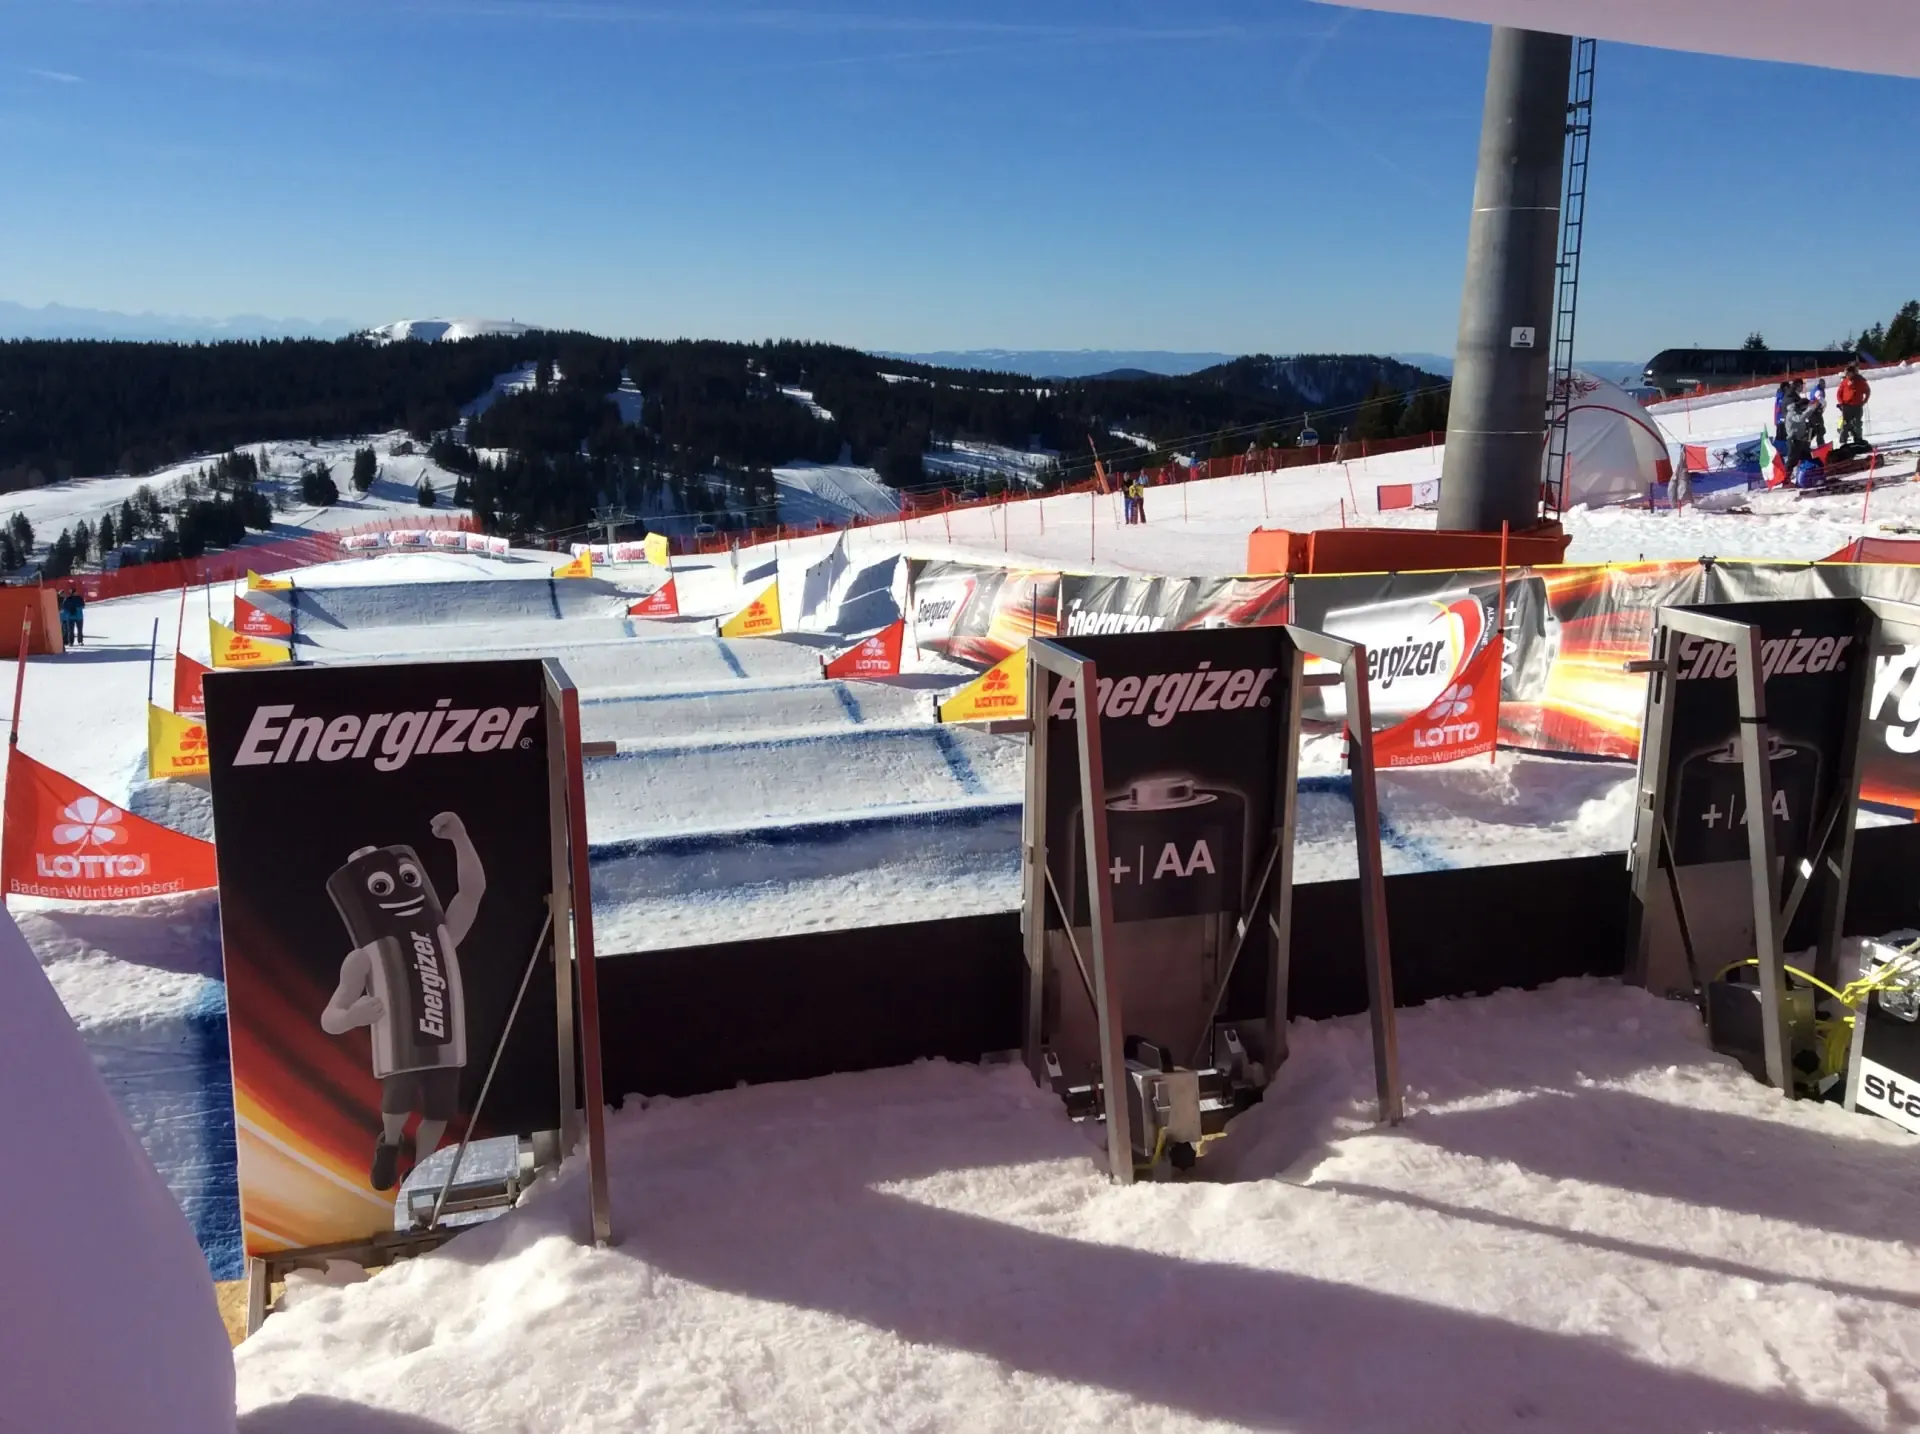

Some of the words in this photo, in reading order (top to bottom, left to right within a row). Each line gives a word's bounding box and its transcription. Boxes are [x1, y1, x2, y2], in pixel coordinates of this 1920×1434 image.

[1519, 329, 1528, 341] 6
[744, 618, 773, 629] LOTTO
[918, 597, 956, 629] Energizer
[856, 659, 891, 670] LOTTO
[1367, 636, 1446, 690] ergizer
[1676, 629, 1853, 686] Enegizer
[974, 696, 1018, 709] LOTTO
[232, 698, 540, 772] Energizer
[1413, 722, 1481, 749] LOTTO
[36, 853, 147, 878] LOTTO
[1152, 839, 1217, 879] AA
[10, 878, 180, 899] Baden-Württemberg
[410, 931, 447, 1038] Energizer
